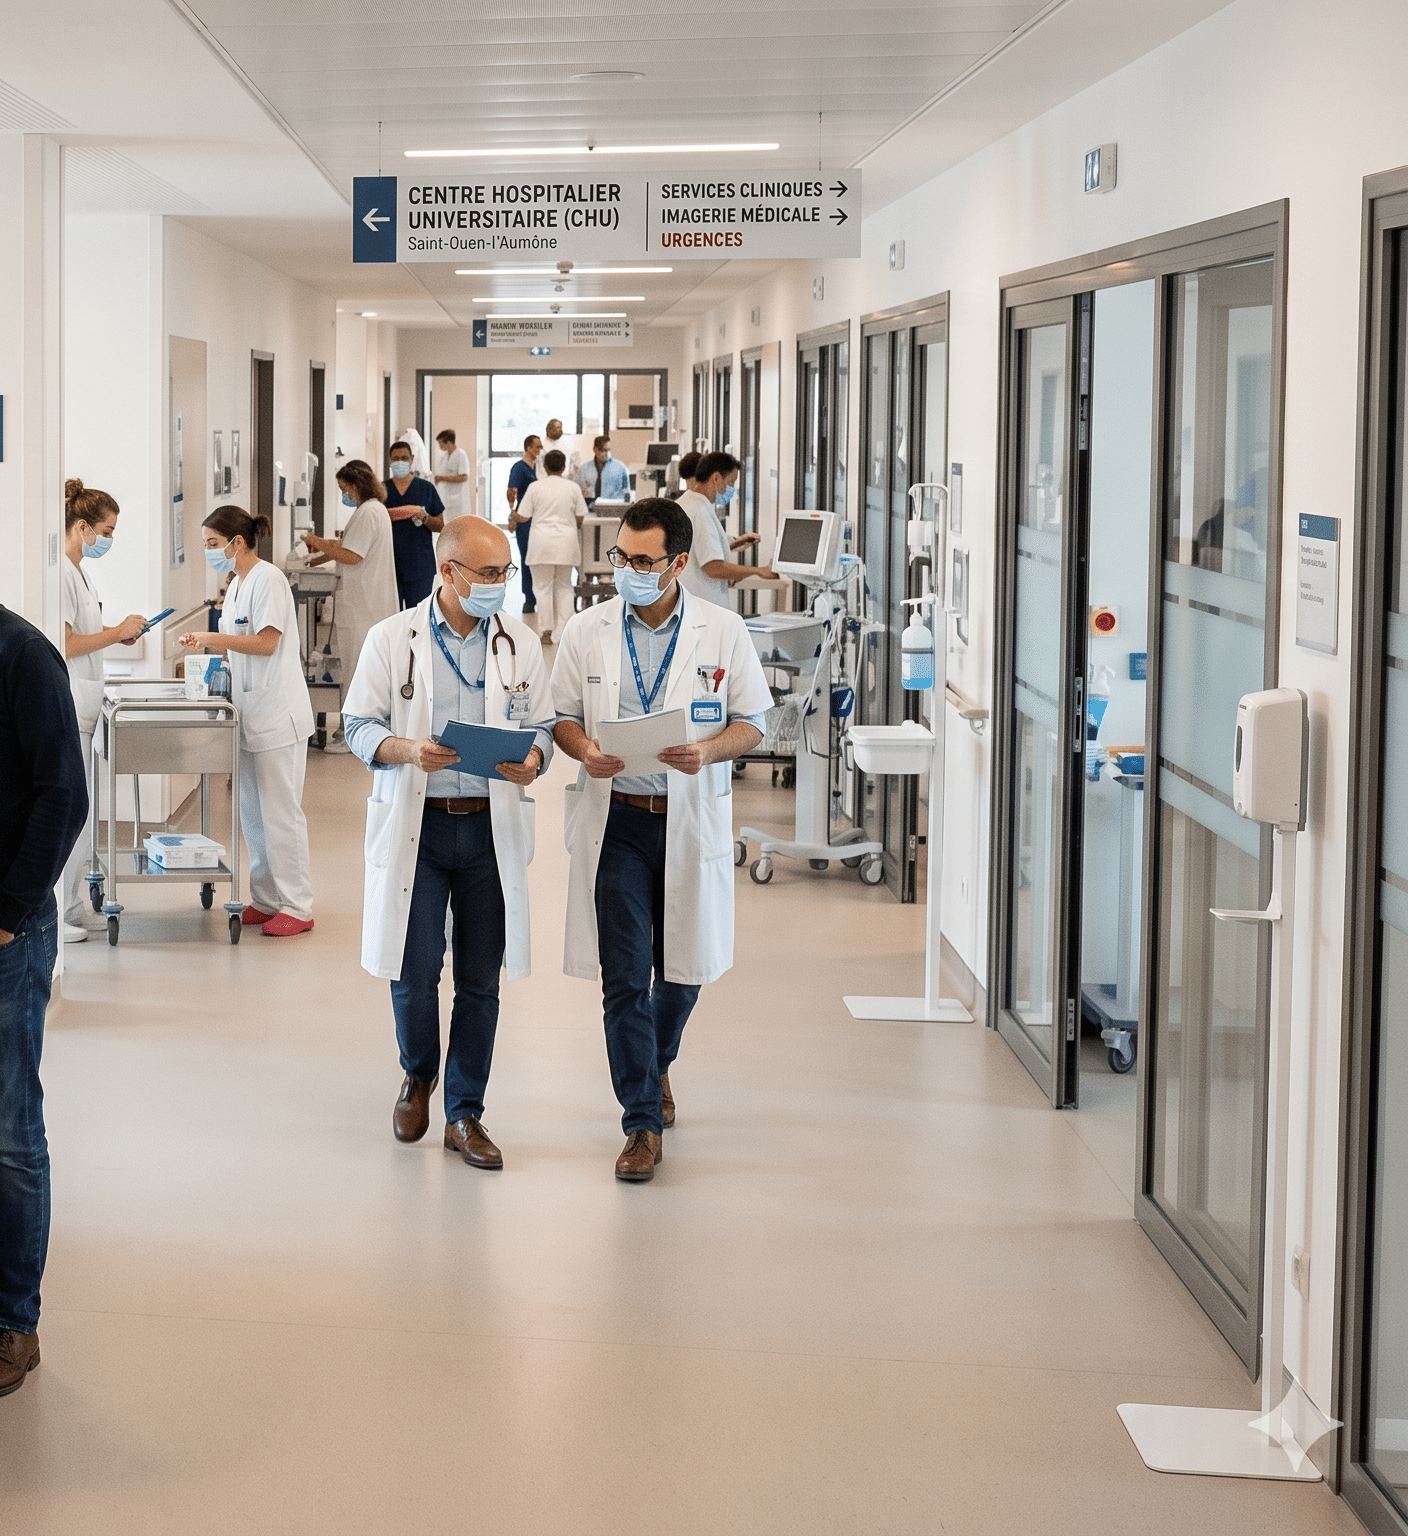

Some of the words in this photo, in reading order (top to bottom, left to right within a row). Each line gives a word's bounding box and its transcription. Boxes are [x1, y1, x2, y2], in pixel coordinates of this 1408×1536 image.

[408, 186, 486, 205] CENTRE
[492, 183, 622, 204] HOSPITALIER
[661, 182, 736, 199] SERVICES
[739, 181, 823, 198] CLINIQUES
[408, 209, 558, 230] UNIVERSITAIRE
[564, 206, 620, 231] (CHU)
[661, 207, 737, 224] IMAGERIE
[741, 203, 821, 223] MÉDICALE
[407, 234, 558, 251] Saint-Ouen-l'Aumône
[661, 231, 743, 248] URGENCES
